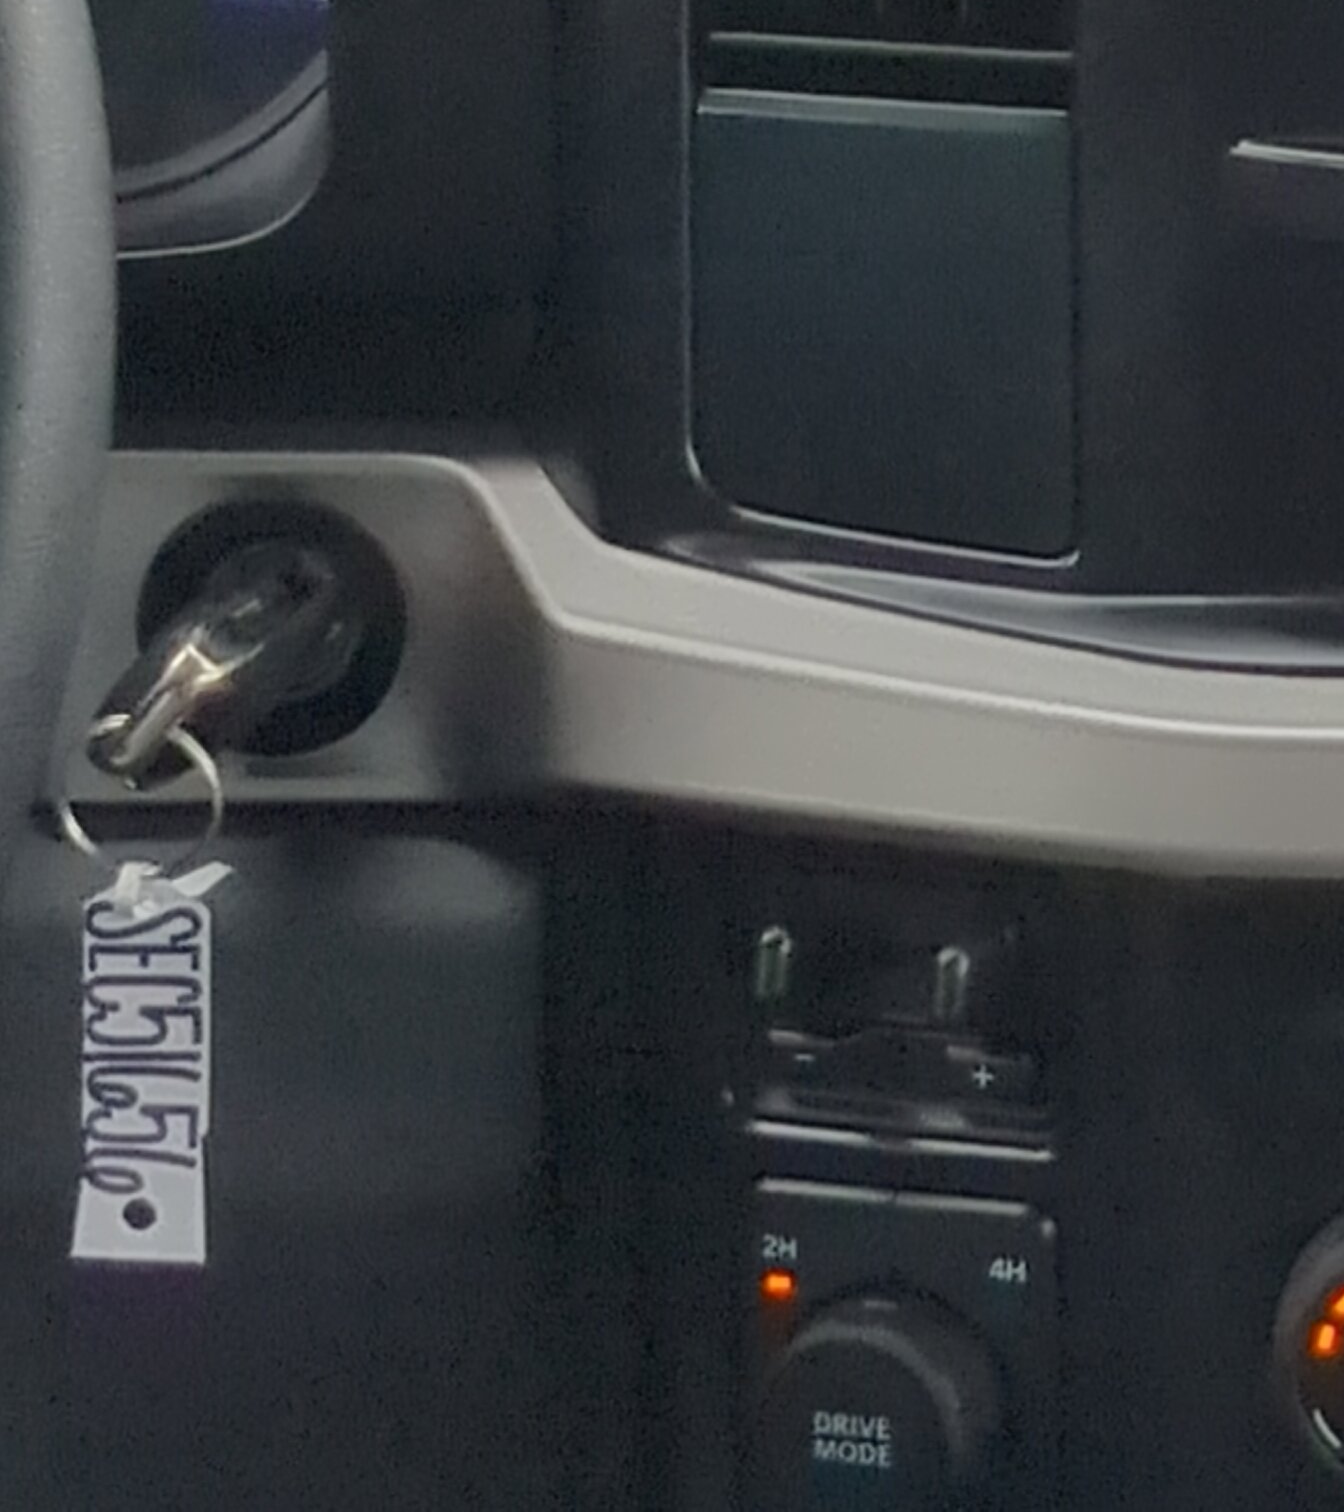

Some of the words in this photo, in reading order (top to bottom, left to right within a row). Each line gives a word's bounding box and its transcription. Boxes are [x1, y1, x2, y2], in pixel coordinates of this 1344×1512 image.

[761, 1234, 798, 1260] 2H
[988, 1257, 1028, 1284] 4H
[812, 1410, 892, 1441] DRIVE
[812, 1437, 892, 1470] MODE
